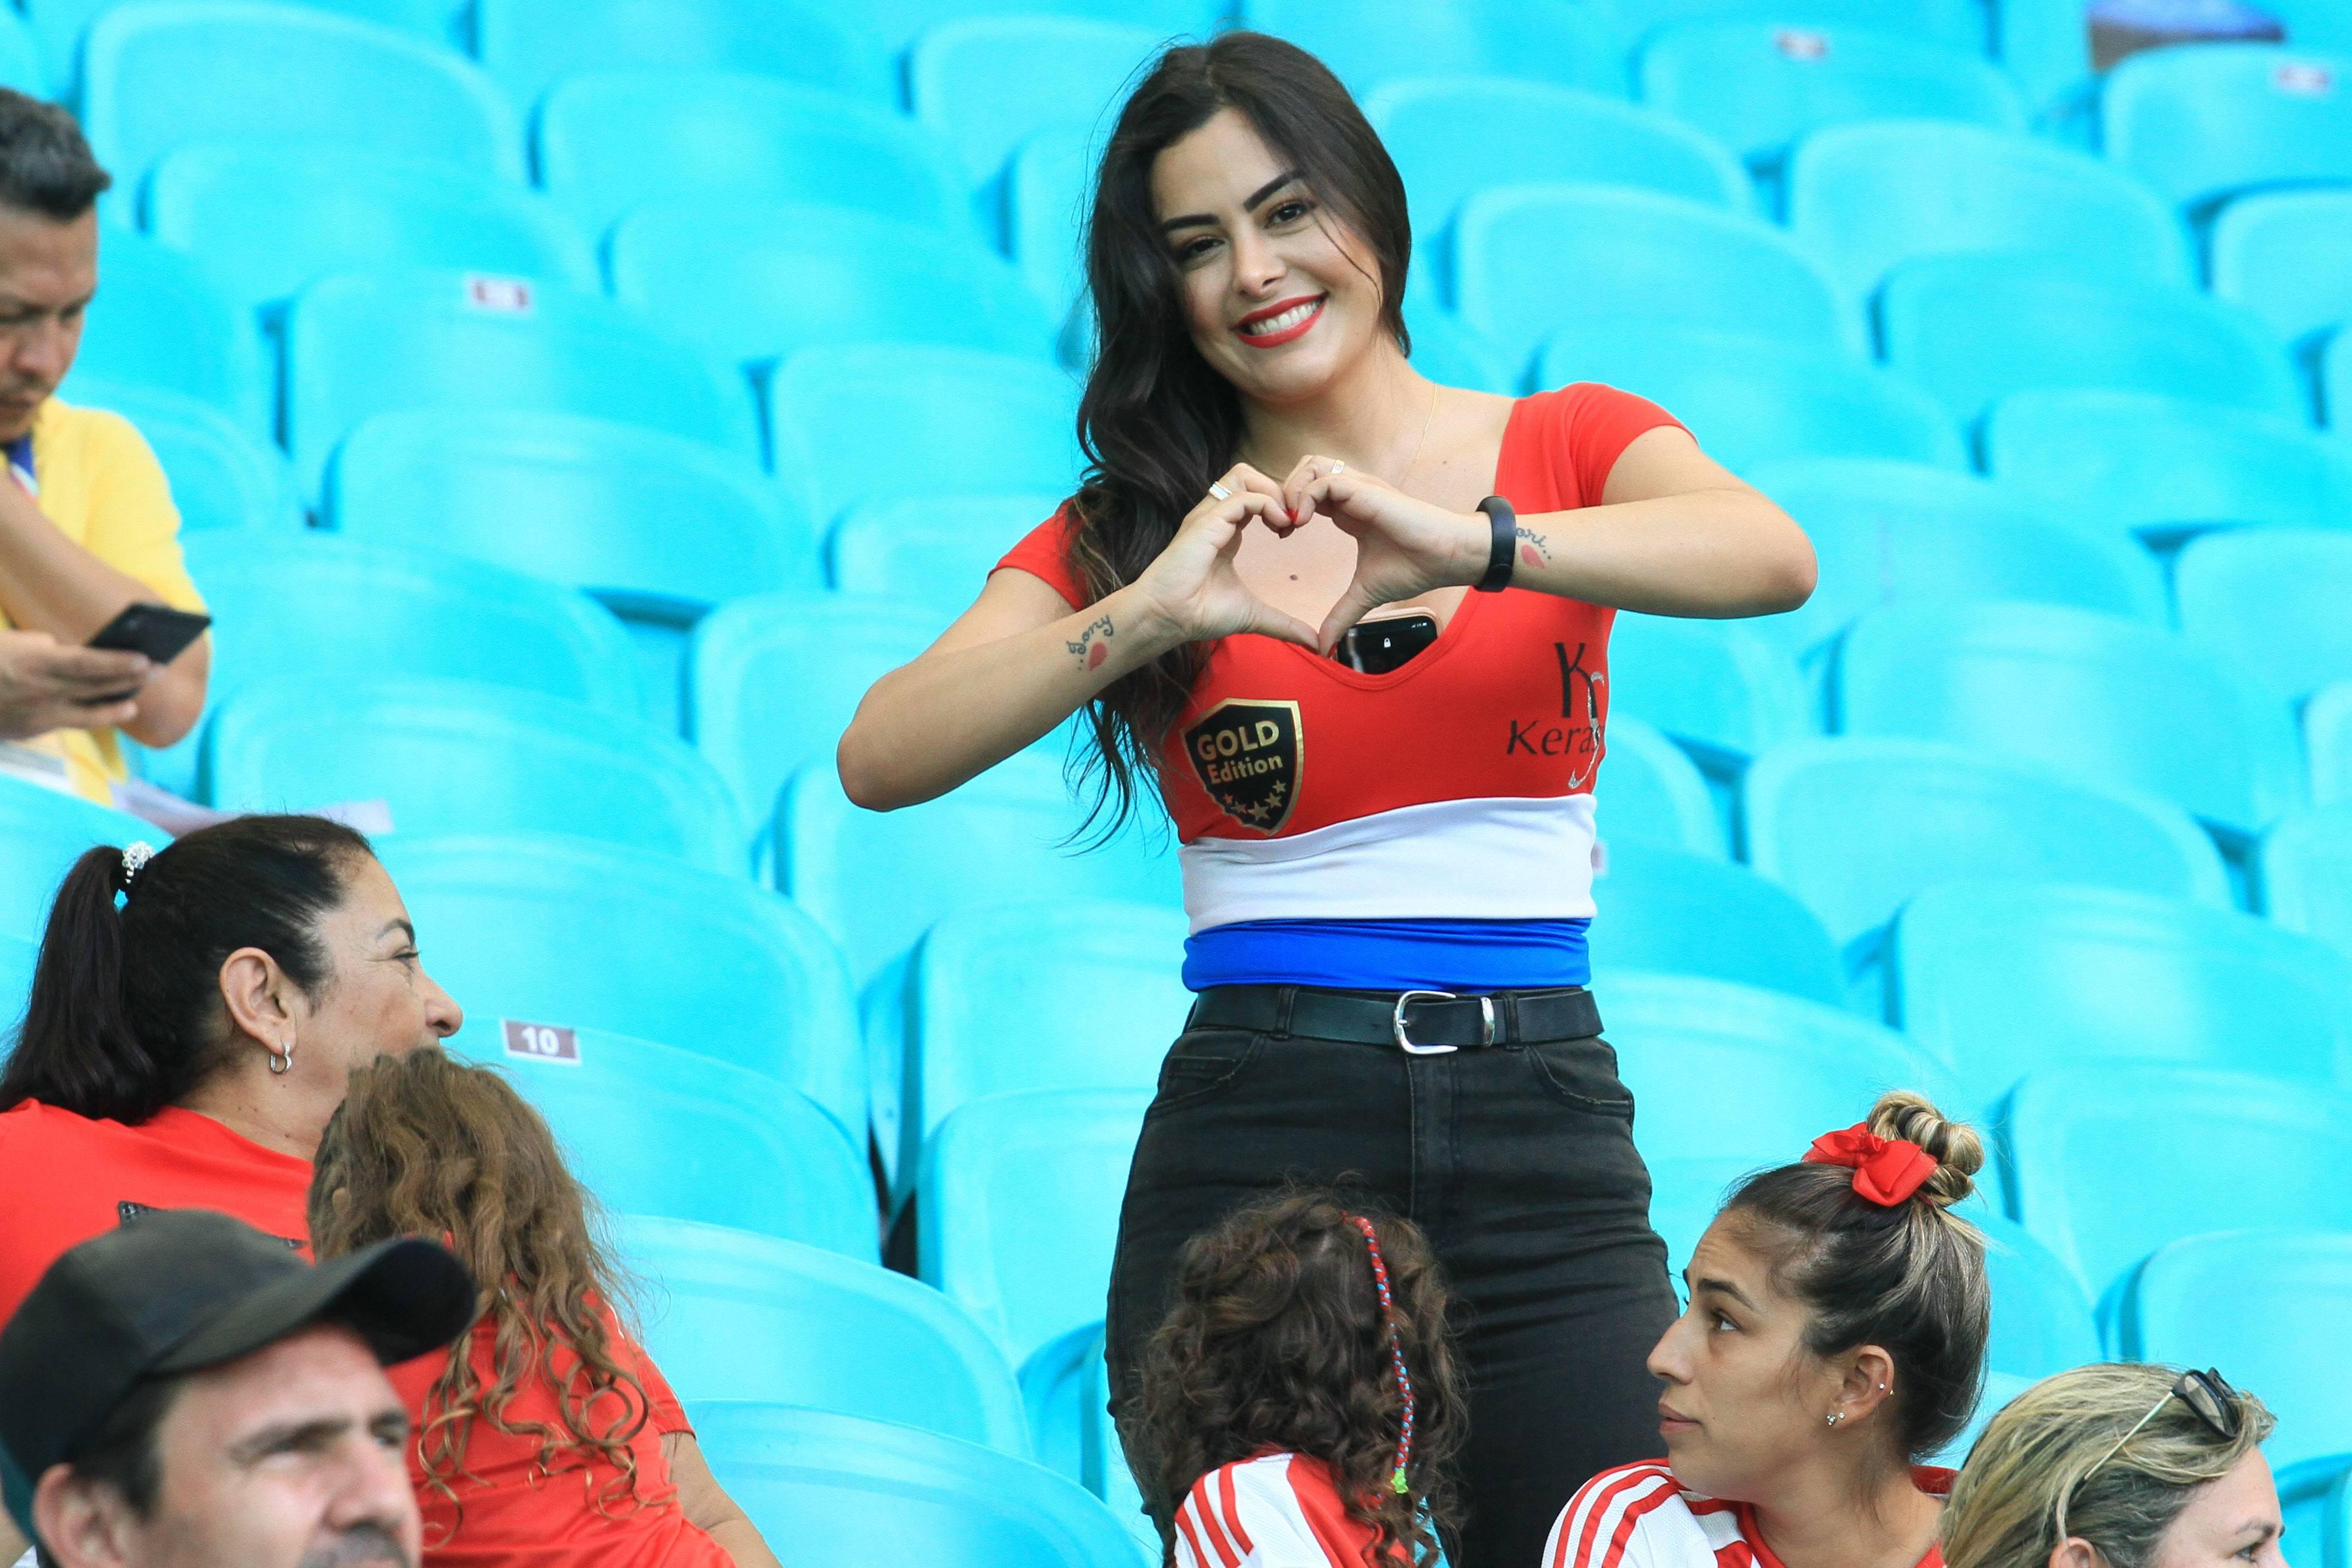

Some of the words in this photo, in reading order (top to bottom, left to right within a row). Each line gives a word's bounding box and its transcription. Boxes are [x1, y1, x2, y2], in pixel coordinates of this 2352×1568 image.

[1197, 721, 1279, 761] GOLD
[1207, 755, 1283, 784] Edition
[521, 1026, 559, 1055] 10
